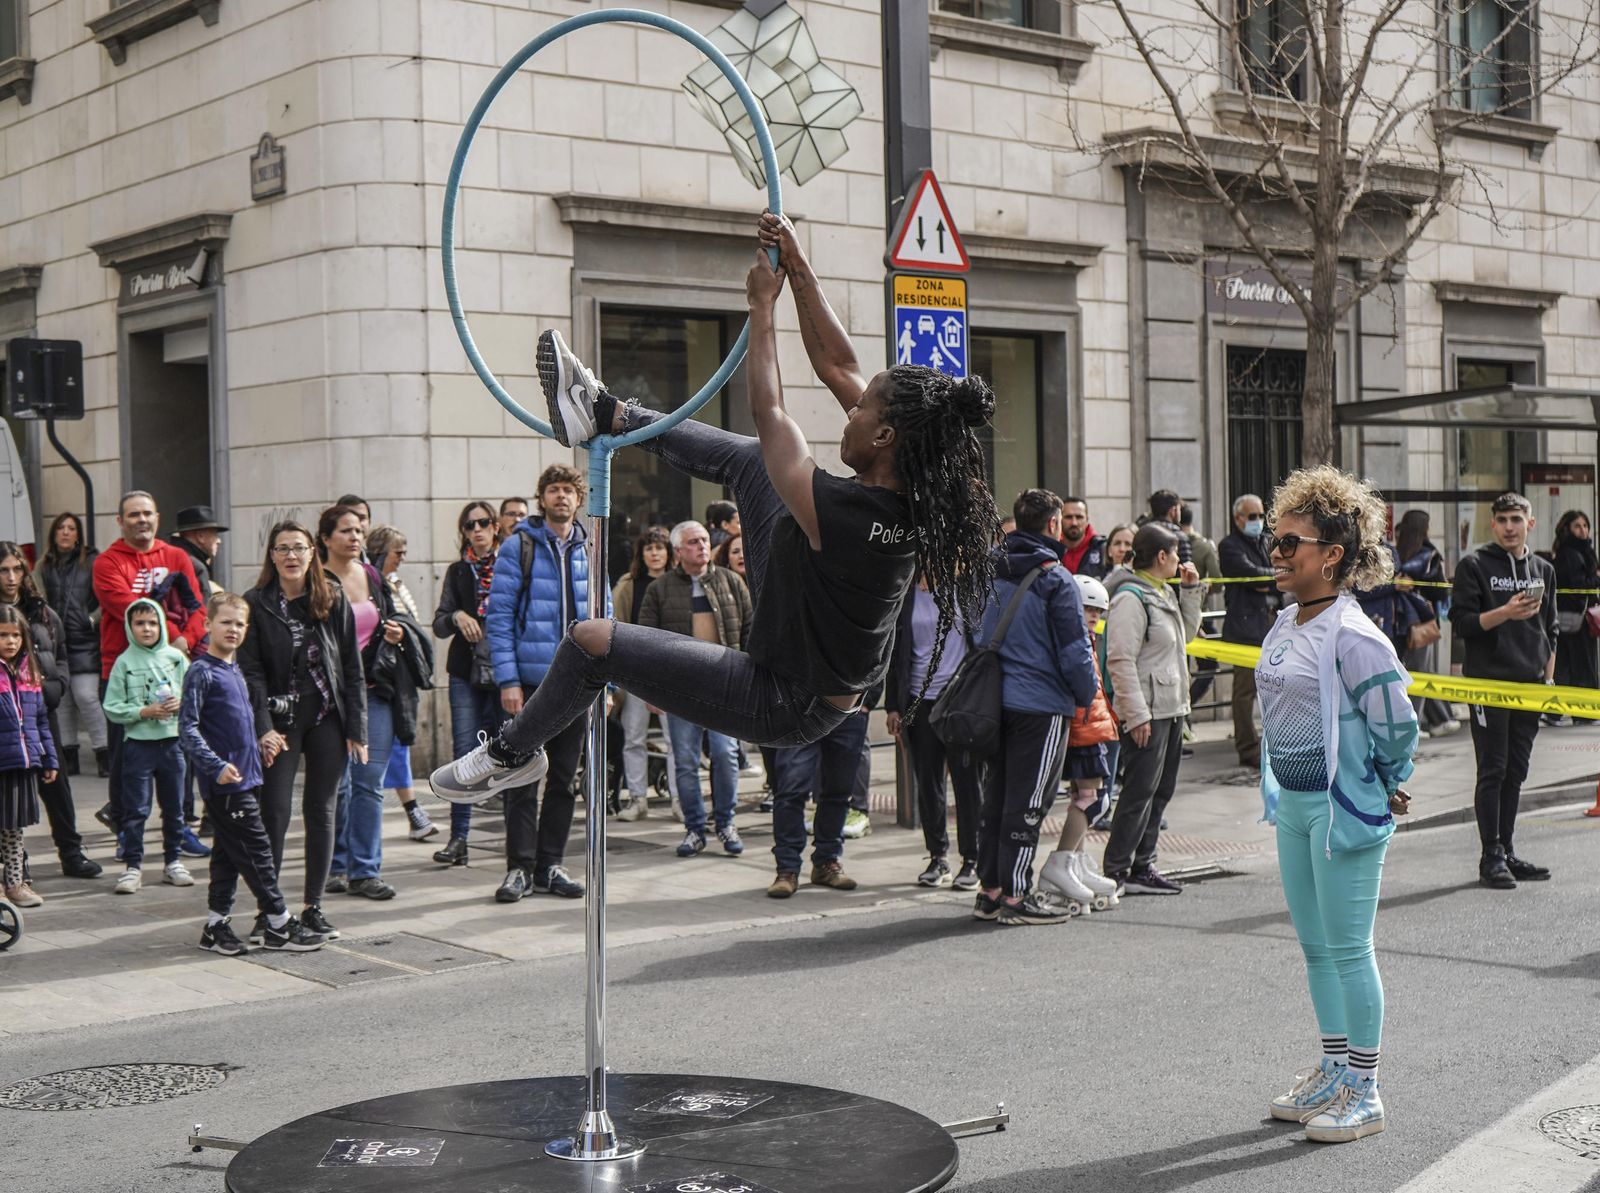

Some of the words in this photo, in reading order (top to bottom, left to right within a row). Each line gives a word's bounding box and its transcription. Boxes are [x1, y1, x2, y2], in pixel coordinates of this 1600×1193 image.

[916, 279, 944, 291] ZONA
[896, 293, 964, 308] RESIDENCIAL
[868, 521, 904, 544] Pole
